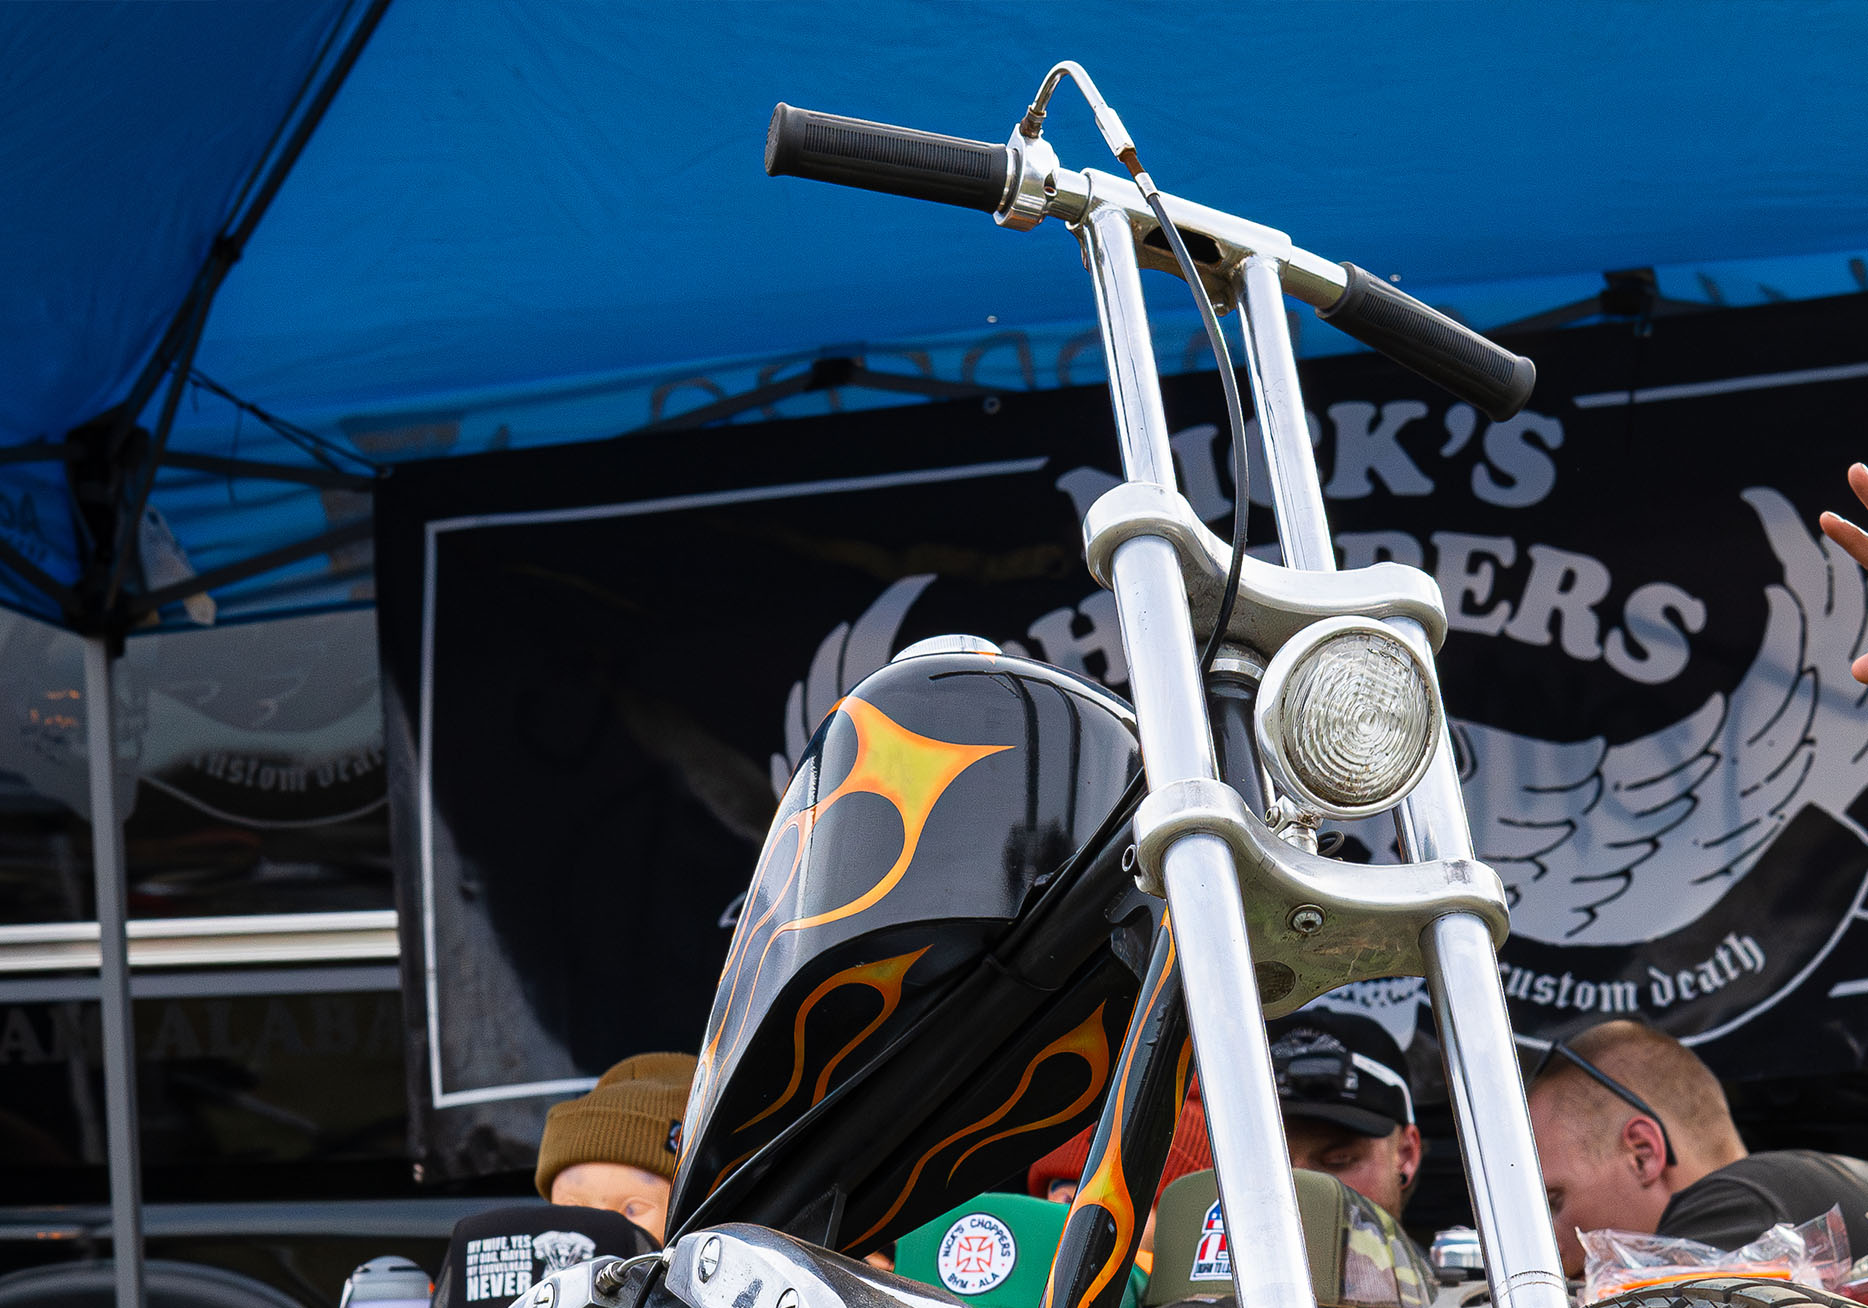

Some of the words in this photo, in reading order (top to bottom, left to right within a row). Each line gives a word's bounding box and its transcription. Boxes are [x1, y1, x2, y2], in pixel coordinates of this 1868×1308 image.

[1647, 935, 1766, 1008] death
[510, 1234, 532, 1249] YES
[943, 1224, 964, 1257] NICK'S
[970, 1218, 1011, 1257] CHOPPERS
[466, 1271, 532, 1302] NEVER
[979, 1272, 1000, 1288] ALA
